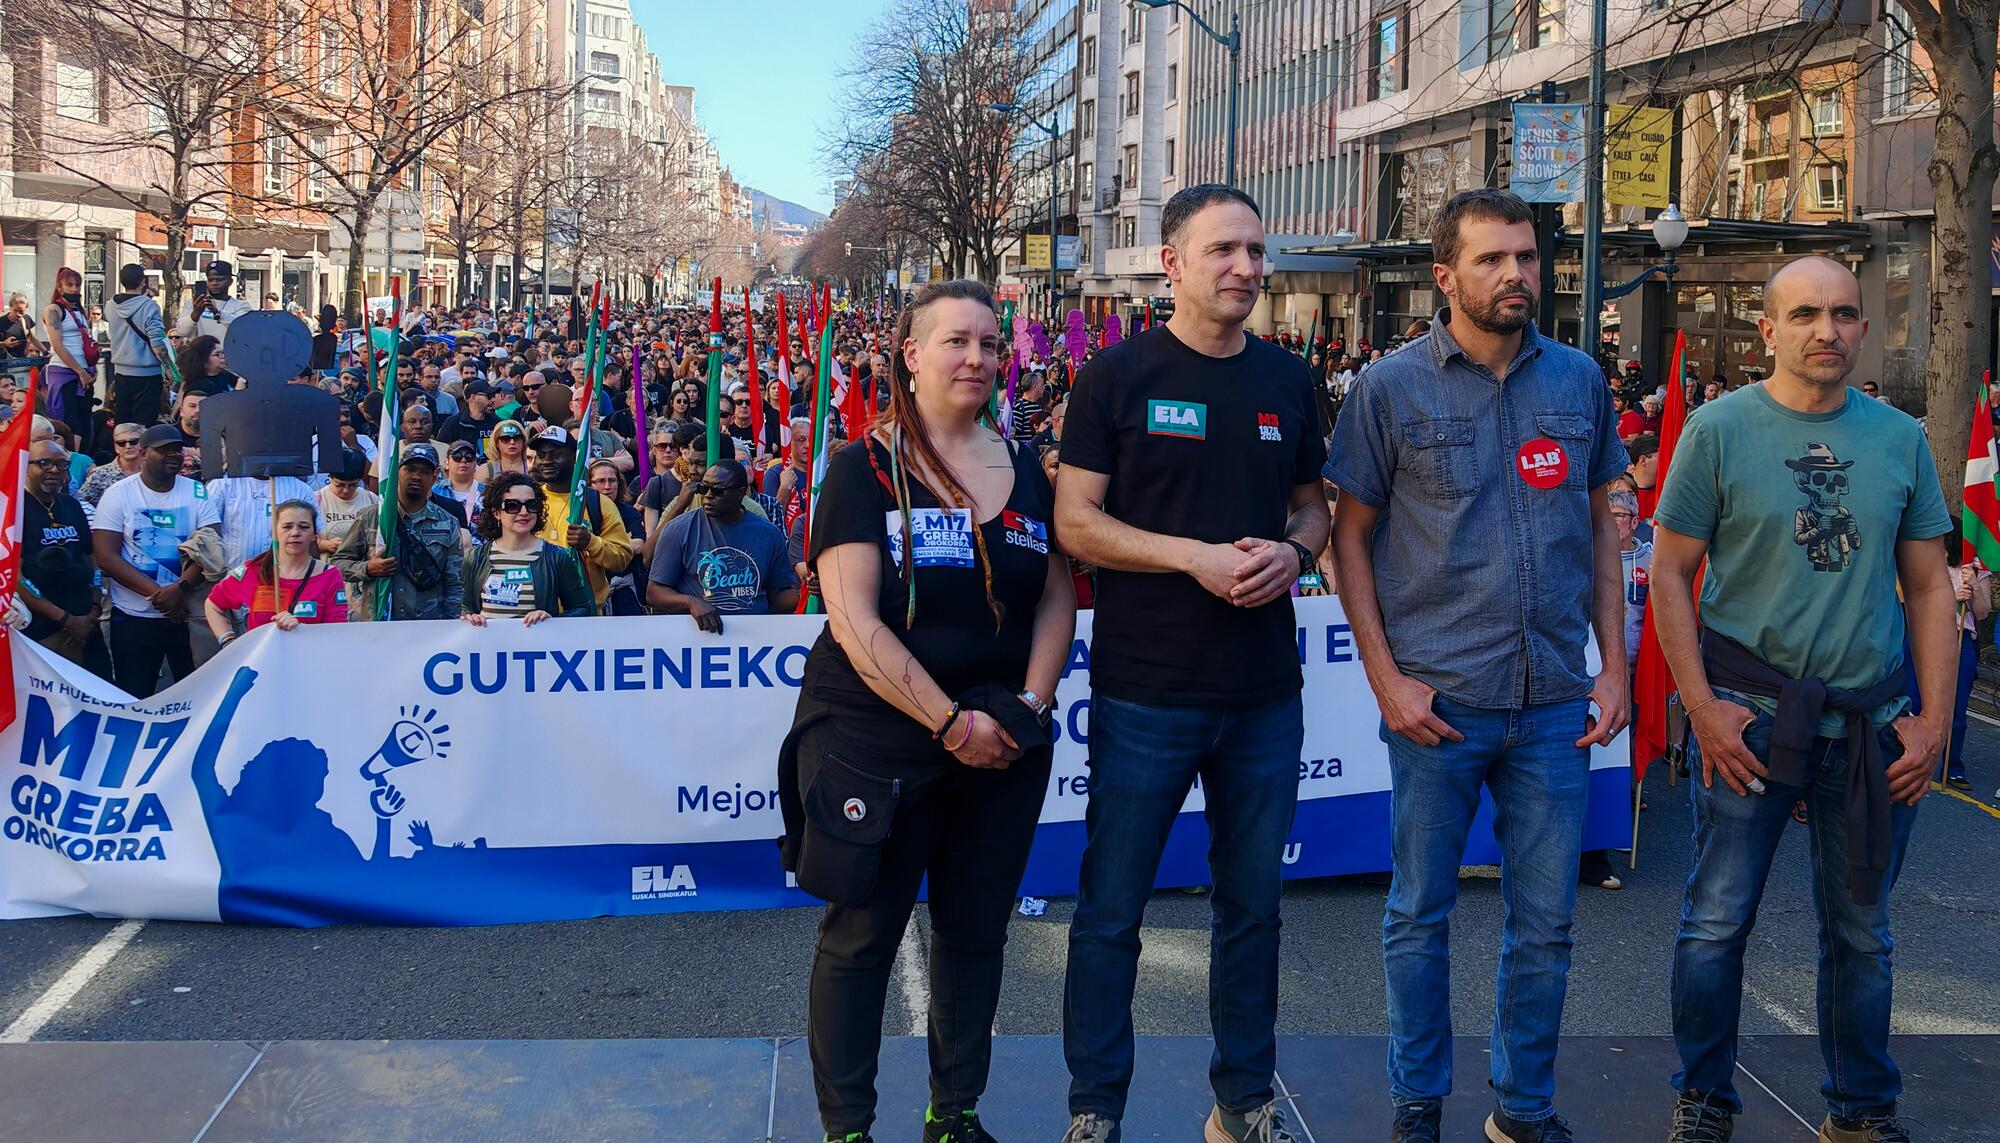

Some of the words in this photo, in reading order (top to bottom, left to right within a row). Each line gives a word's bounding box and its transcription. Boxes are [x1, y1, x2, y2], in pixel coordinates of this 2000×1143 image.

[1520, 127, 1561, 144] DENISE
[1641, 132, 1665, 143] CIUDAD
[1520, 145, 1556, 161] SCOTT
[1613, 150, 1632, 161] KALEA
[1519, 163, 1562, 179] BROWN
[1612, 170, 1632, 180] ETXEA
[1639, 172, 1656, 183] CASA
[1155, 405, 1199, 427] ELA
[1520, 450, 1561, 470] LAB
[925, 515, 967, 531] M17
[922, 531, 969, 542] GREBA
[924, 540, 970, 548] OROKORRA
[507, 570, 529, 580] ELA
[708, 566, 757, 589] Beach
[731, 586, 755, 598] VIBES
[423, 644, 808, 696] GUTXIENEKO
[29, 675, 54, 692] 17M
[20, 693, 191, 788] M17
[11, 774, 173, 836] GREBA
[3, 815, 167, 862] OROKORRA
[631, 864, 697, 894] ELA
[631, 893, 657, 901] EUSKAL
[657, 890, 698, 899] SINDIKATUA
